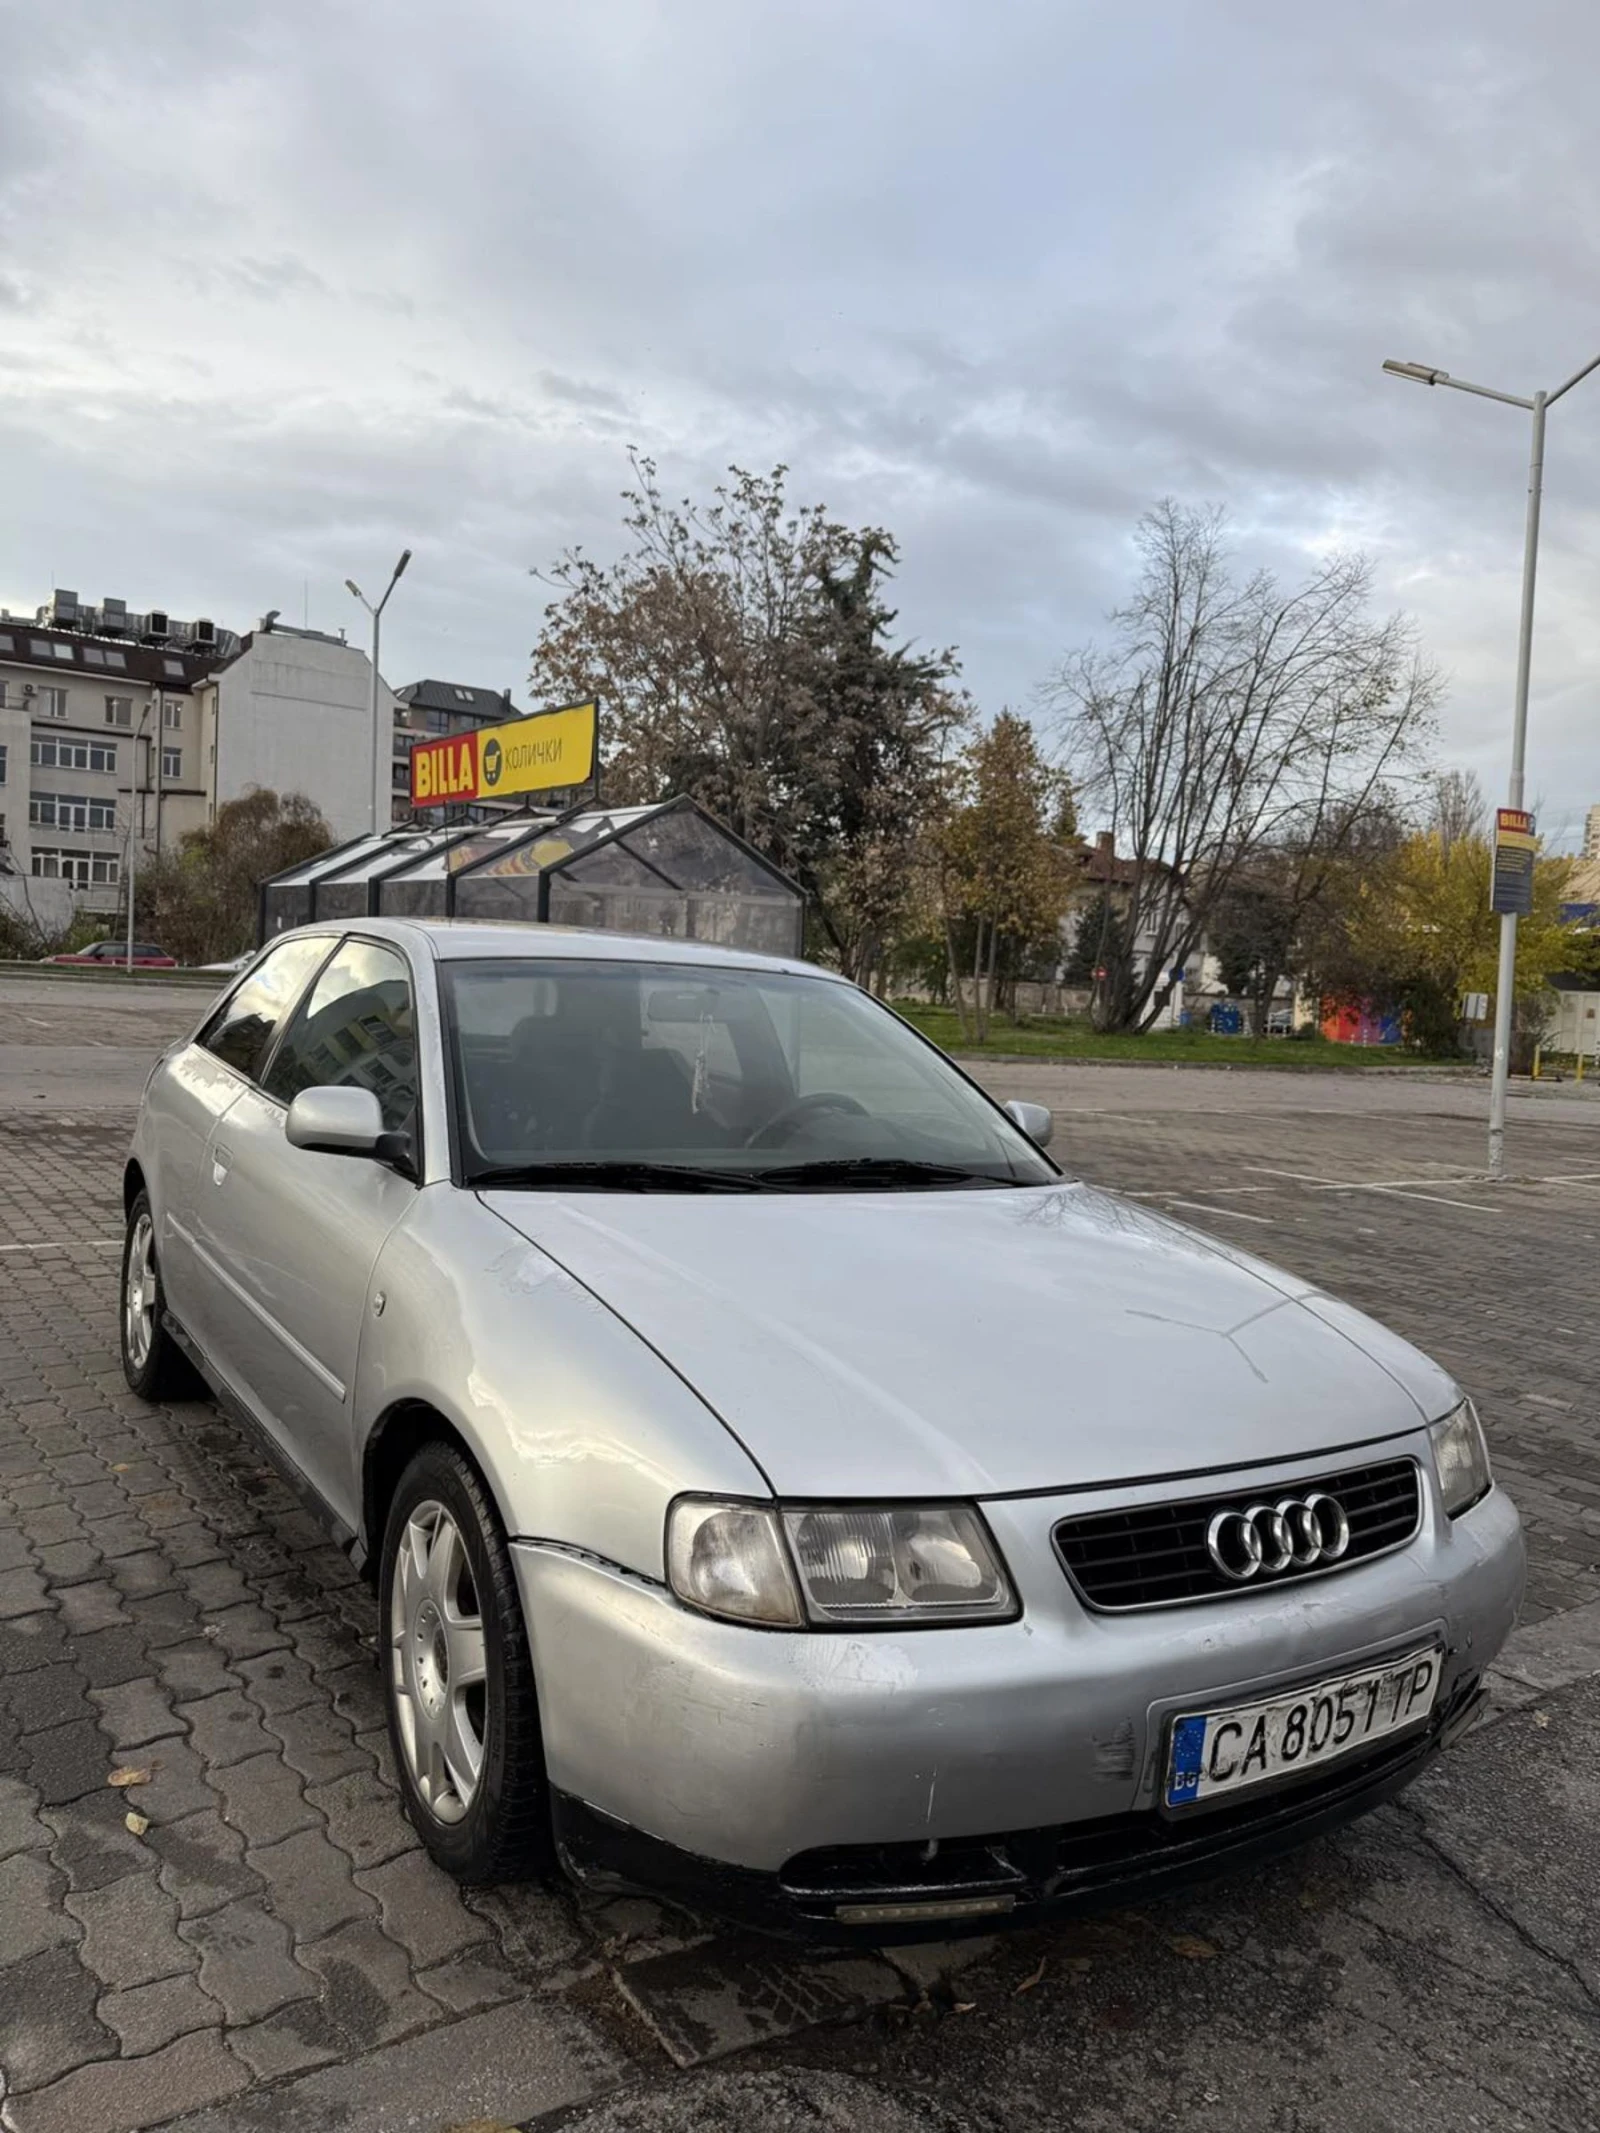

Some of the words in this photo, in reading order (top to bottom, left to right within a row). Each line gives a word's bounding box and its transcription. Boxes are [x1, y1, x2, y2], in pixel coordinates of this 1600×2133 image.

[415, 744, 475, 798] BILLA
[504, 739, 563, 770] КОЛИЧКИ
[1209, 1714, 1268, 1782] CA
[1174, 1771, 1197, 1791] BG
